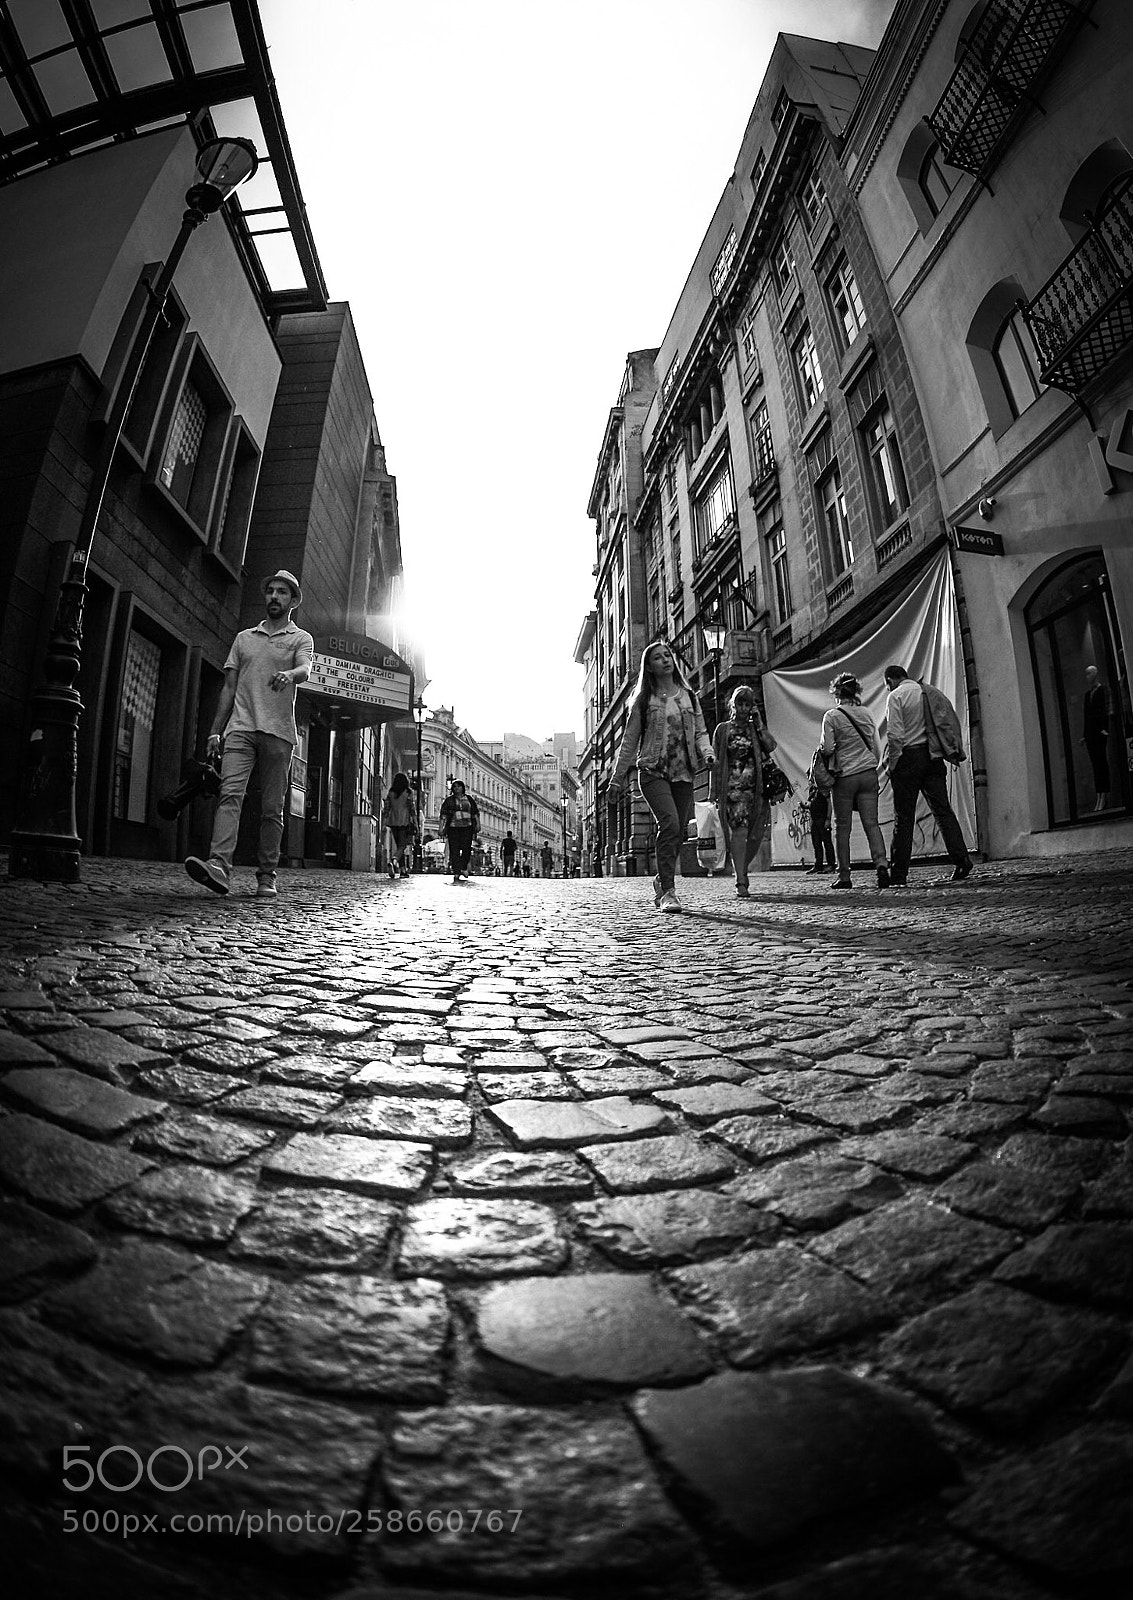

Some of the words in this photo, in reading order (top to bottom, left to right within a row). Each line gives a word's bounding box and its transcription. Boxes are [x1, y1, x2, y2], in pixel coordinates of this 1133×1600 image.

[329, 636, 379, 661] BELUGA
[323, 657, 332, 665] 11
[335, 659, 361, 671] DAMIAN
[364, 666, 395, 679] DRAGHICI
[326, 667, 339, 677] THE
[346, 672, 375, 685] COLOURS
[318, 676, 326, 684] 18
[337, 680, 370, 693] FREESTAY
[323, 686, 341, 695] RSVP
